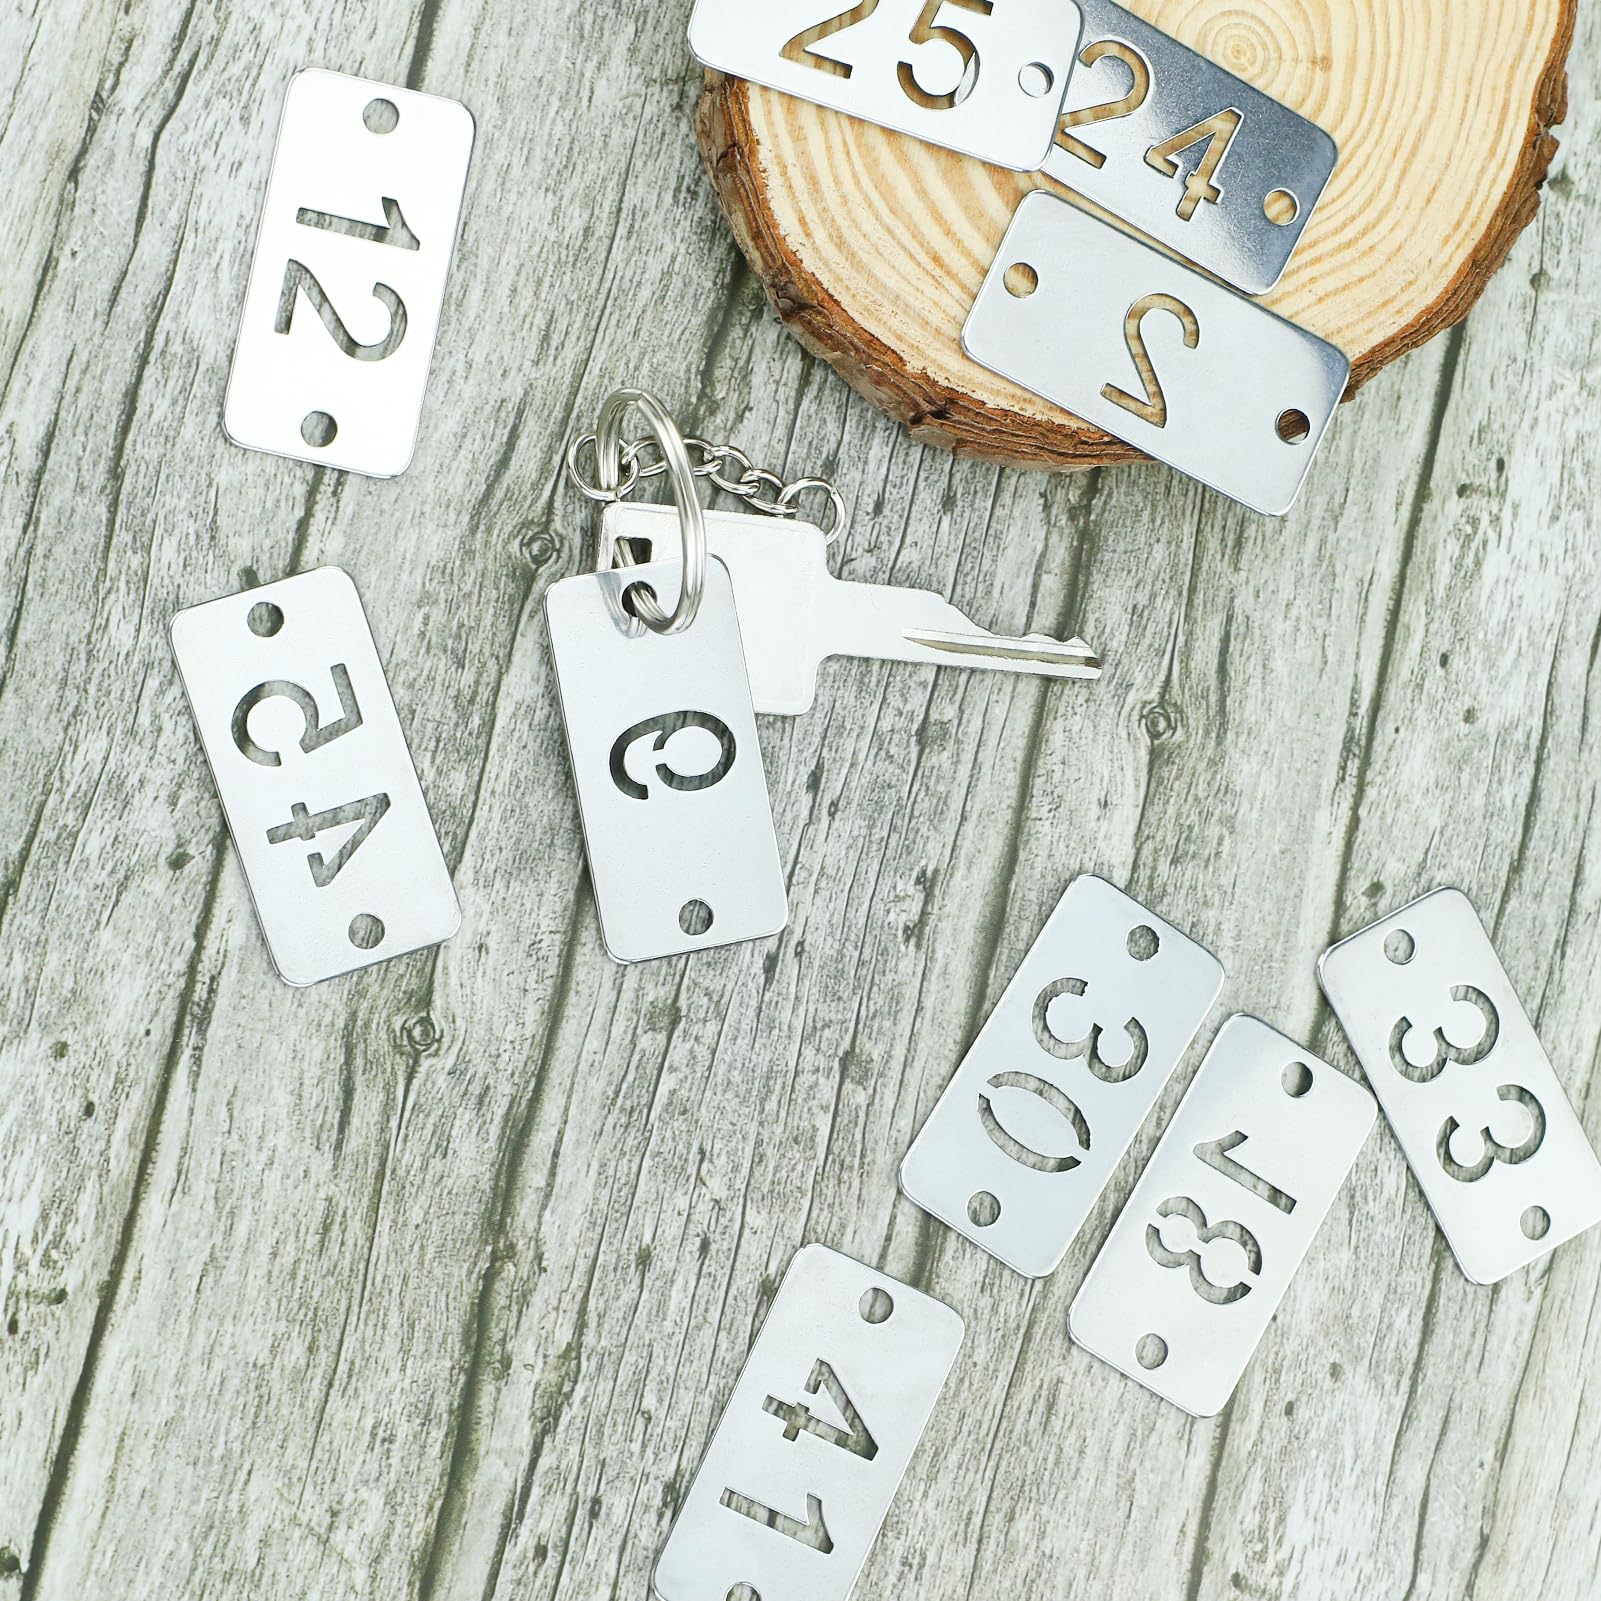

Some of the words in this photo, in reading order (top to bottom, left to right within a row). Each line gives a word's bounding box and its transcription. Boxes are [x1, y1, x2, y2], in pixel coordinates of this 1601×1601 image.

[779, 0, 994, 110] 25
[1054, 38, 1243, 222] 24
[273, 195, 421, 363] 12
[977, 975, 1150, 1174] 30
[719, 1356, 879, 1556] 41
